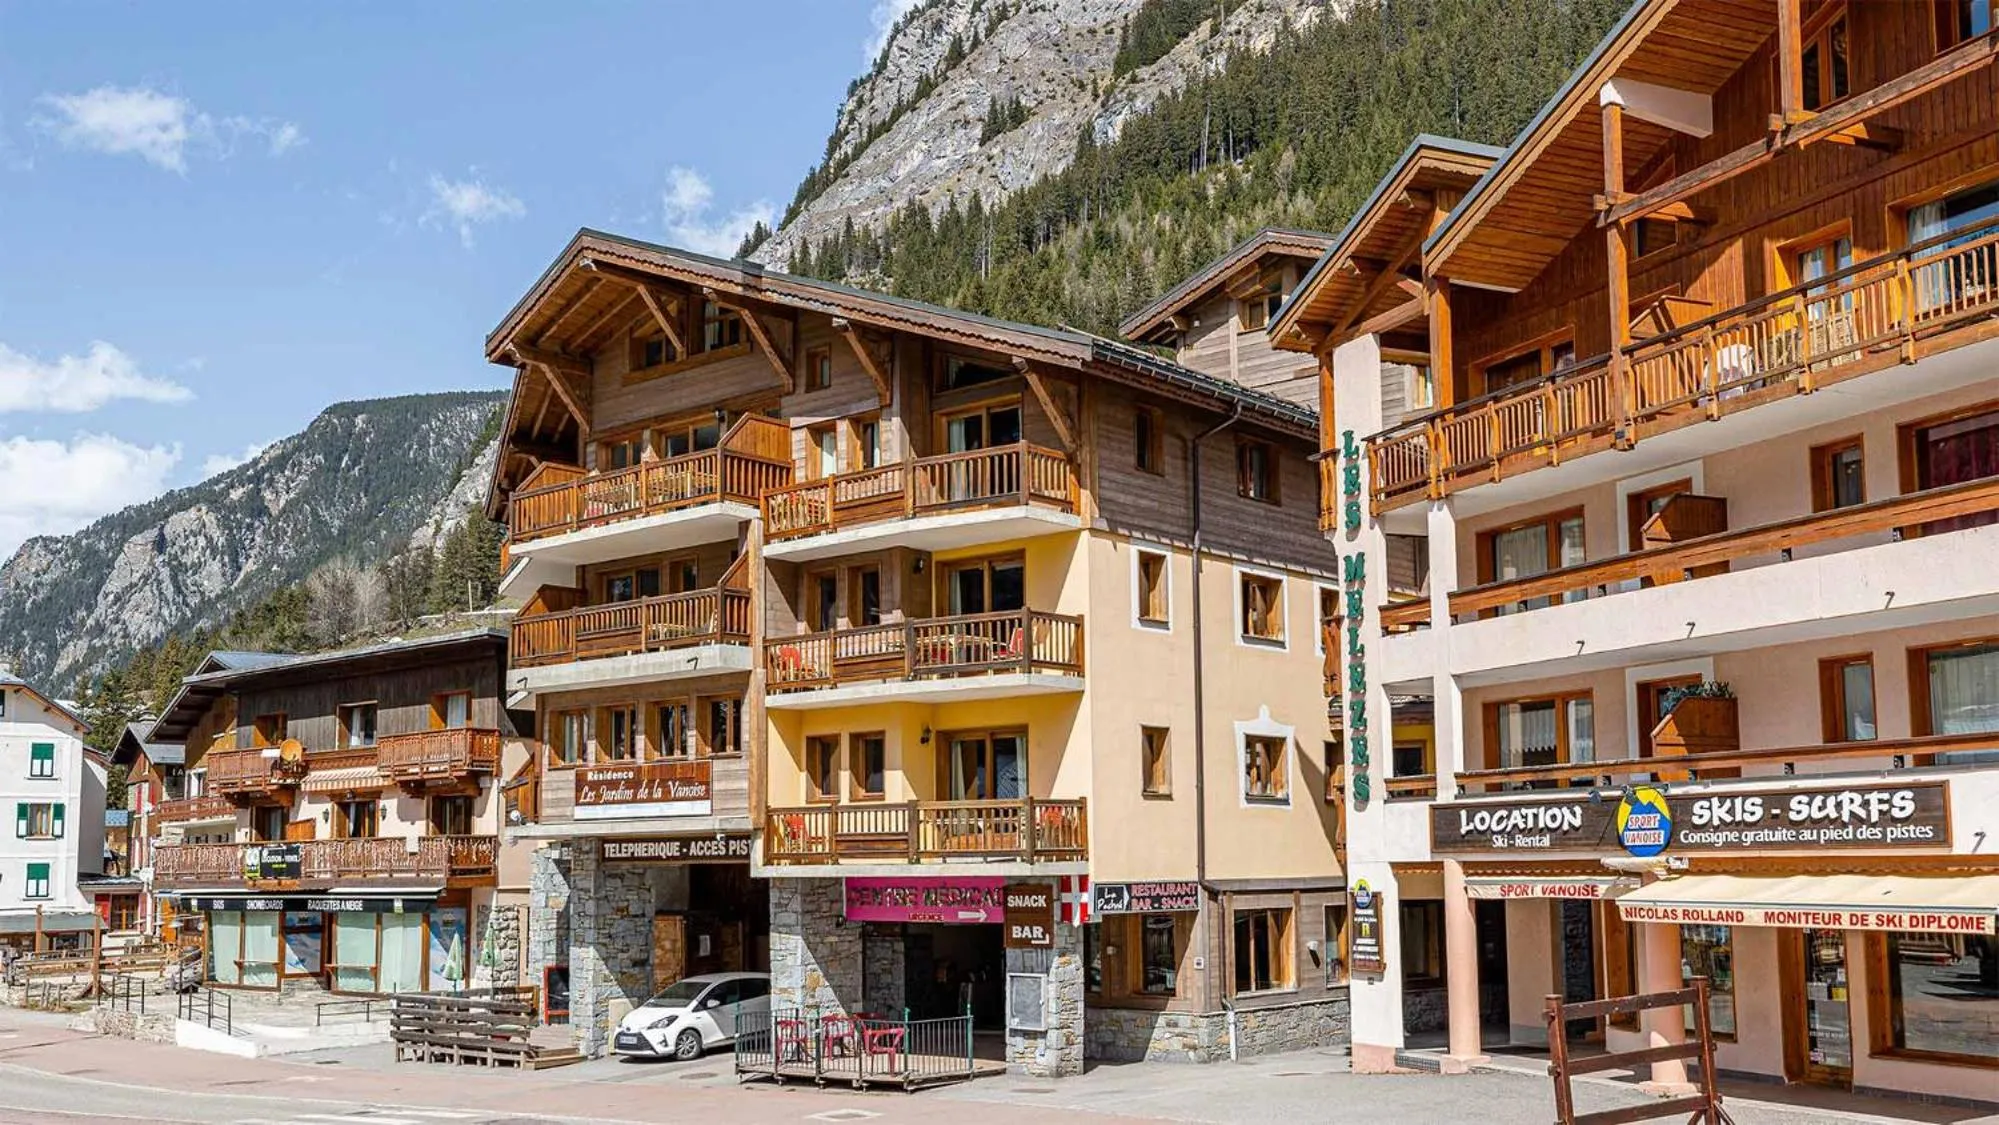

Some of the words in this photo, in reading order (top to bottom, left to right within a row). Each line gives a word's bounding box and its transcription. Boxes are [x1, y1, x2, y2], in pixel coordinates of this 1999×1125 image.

[1343, 430, 1361, 529] LES
[1343, 552, 1370, 801] MELEZES
[579, 785, 596, 803] Les
[600, 781, 634, 804] Jardins
[637, 779, 649, 799] de
[653, 779, 662, 798] la
[668, 780, 706, 798] Vanoise
[1691, 797, 1763, 826] SKIS
[1788, 790, 1916, 824] SURFS
[1459, 805, 1582, 835] LOCATION
[1629, 815, 1658, 828] SPORT
[1492, 835, 1508, 848] Ski
[1515, 833, 1550, 847] Rental
[1625, 831, 1663, 844] VANOISE
[1680, 829, 1740, 847] Consigne
[1742, 826, 1796, 847] gratuite
[1799, 827, 1817, 841] au
[1820, 825, 1853, 845] pied
[1856, 825, 1882, 840] des
[1887, 823, 1934, 843] pistes
[604, 842, 681, 859] TELEPHERIQUE
[847, 886, 918, 908] CENTRE
[1131, 884, 1197, 896] RESTAURANT
[1500, 884, 1534, 897] SPORT
[1541, 884, 1600, 898] VANOISE
[1007, 895, 1047, 907] SNACK
[1131, 899, 1151, 910] BAR
[1161, 896, 1197, 909] SNACK
[1625, 908, 1679, 921] NICOLAS
[1682, 910, 1744, 923] ROLLAND
[1764, 911, 1842, 926] MONITEUR
[1850, 914, 1869, 927] DE
[1875, 914, 1902, 928] SKI
[1909, 915, 1986, 931] DIPLOME
[1012, 926, 1043, 939] BAR
